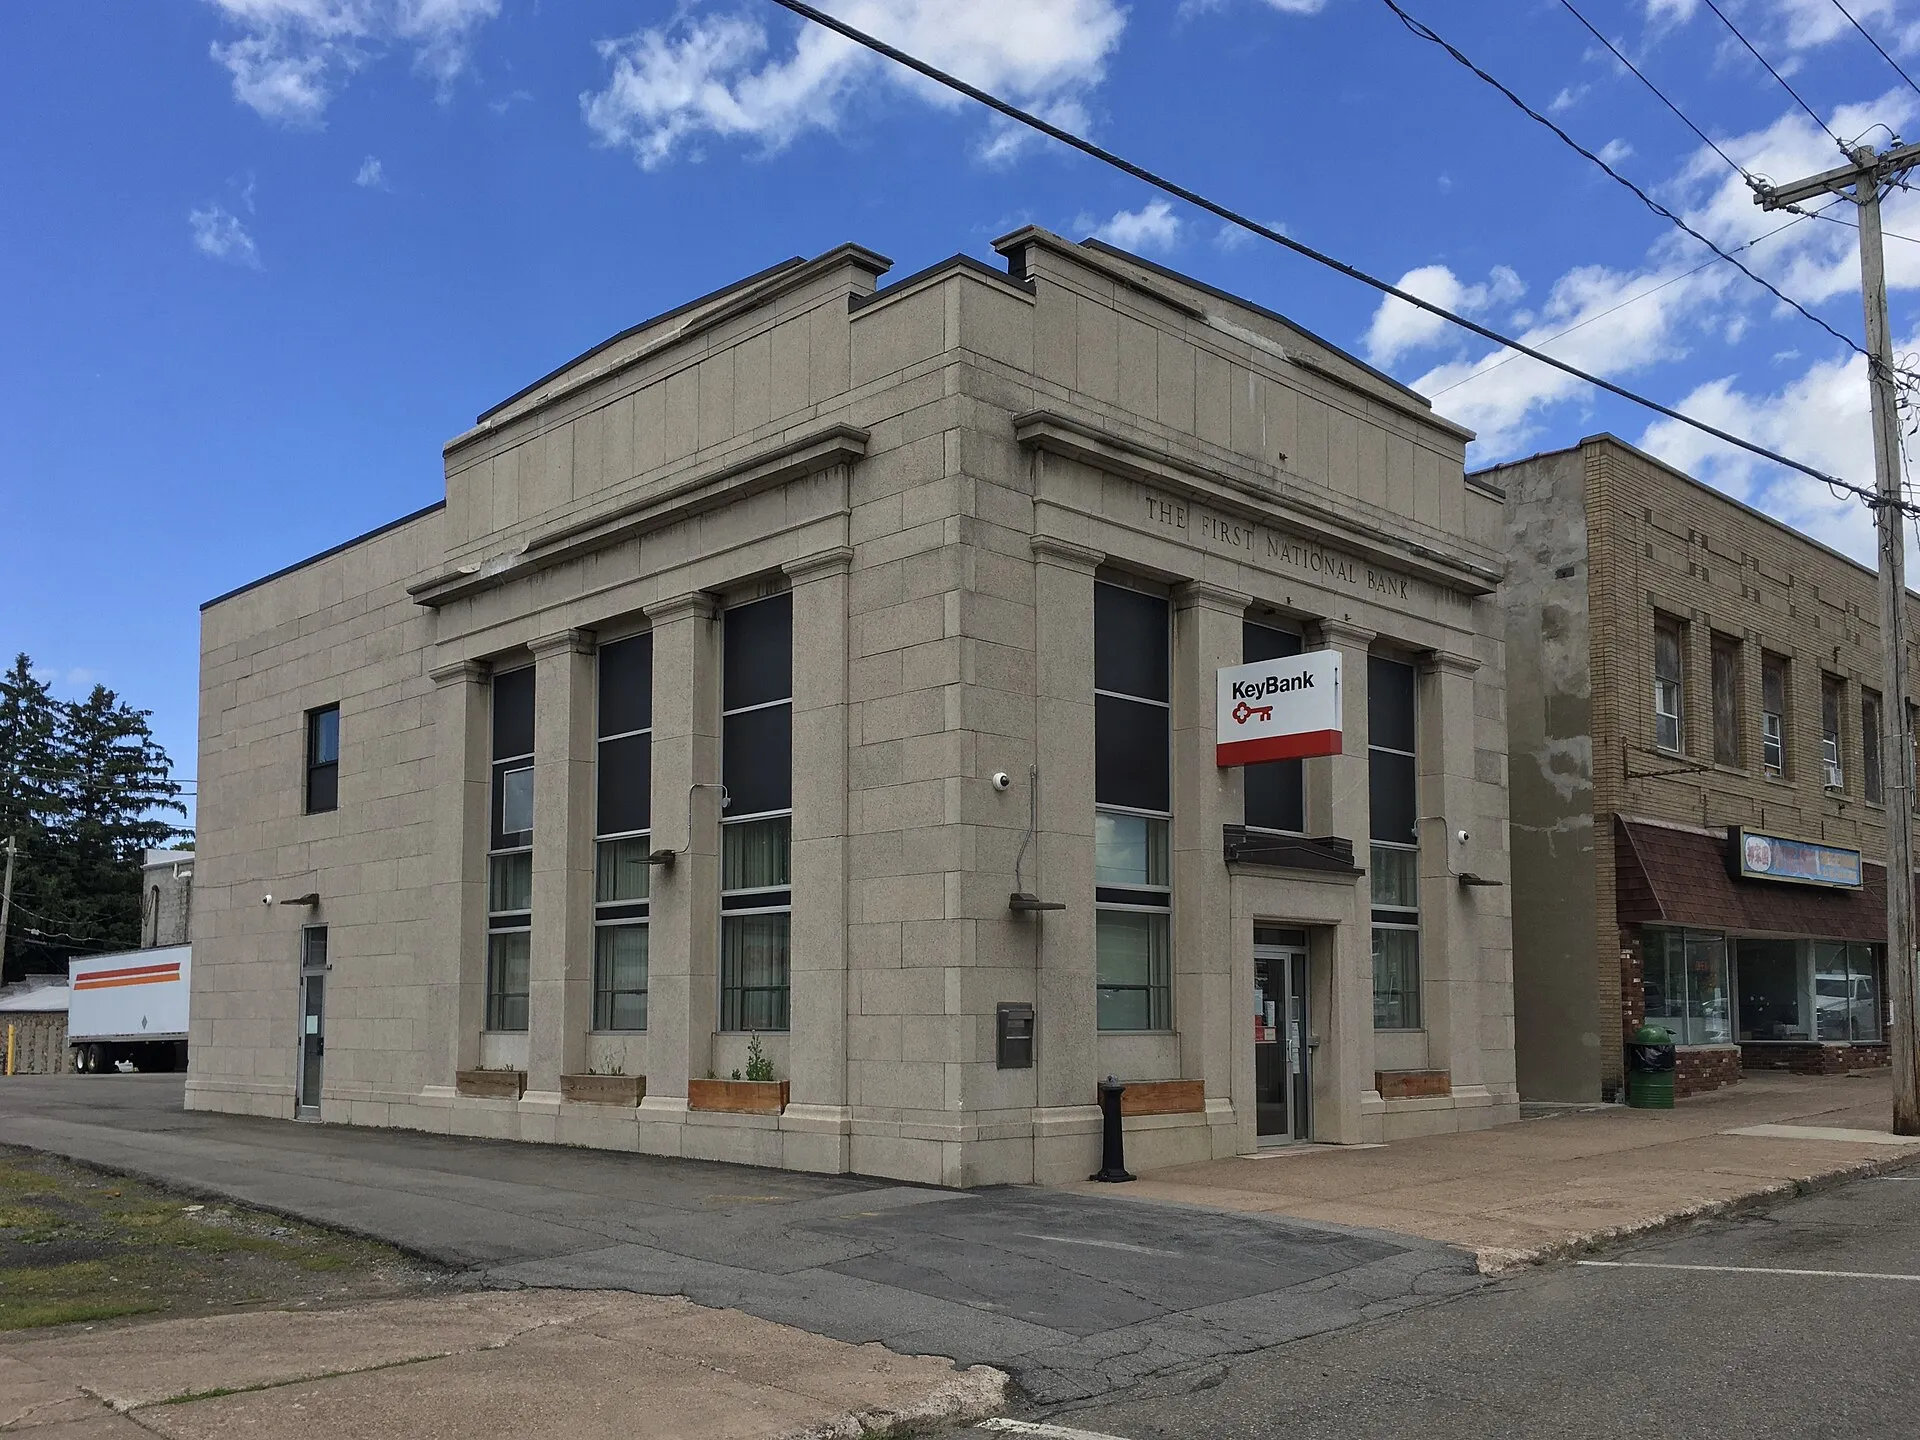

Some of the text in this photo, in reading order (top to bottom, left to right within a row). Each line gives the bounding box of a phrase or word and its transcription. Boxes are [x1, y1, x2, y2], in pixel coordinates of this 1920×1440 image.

[1145, 497, 1409, 600] THE FIRST NATIONAL BANK
[1232, 670, 1315, 700] KeyBank
